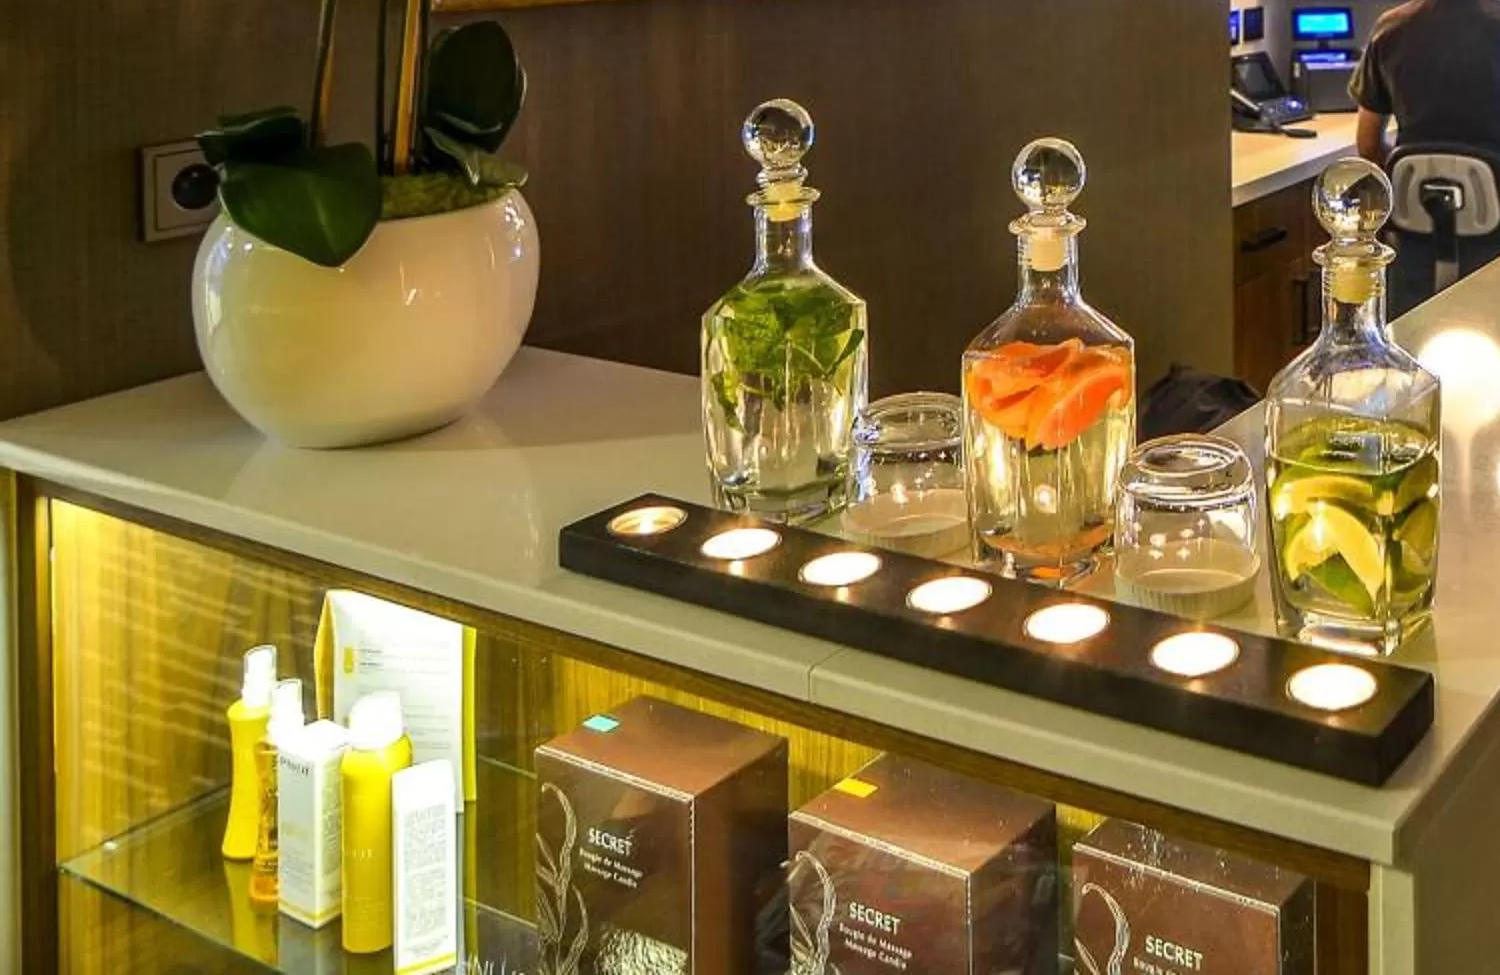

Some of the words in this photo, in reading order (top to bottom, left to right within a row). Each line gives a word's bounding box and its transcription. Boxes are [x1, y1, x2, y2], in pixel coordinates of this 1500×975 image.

[588, 828, 632, 857] SECRET
[849, 901, 901, 936] SECRET
[1145, 934, 1203, 972] SECRET
